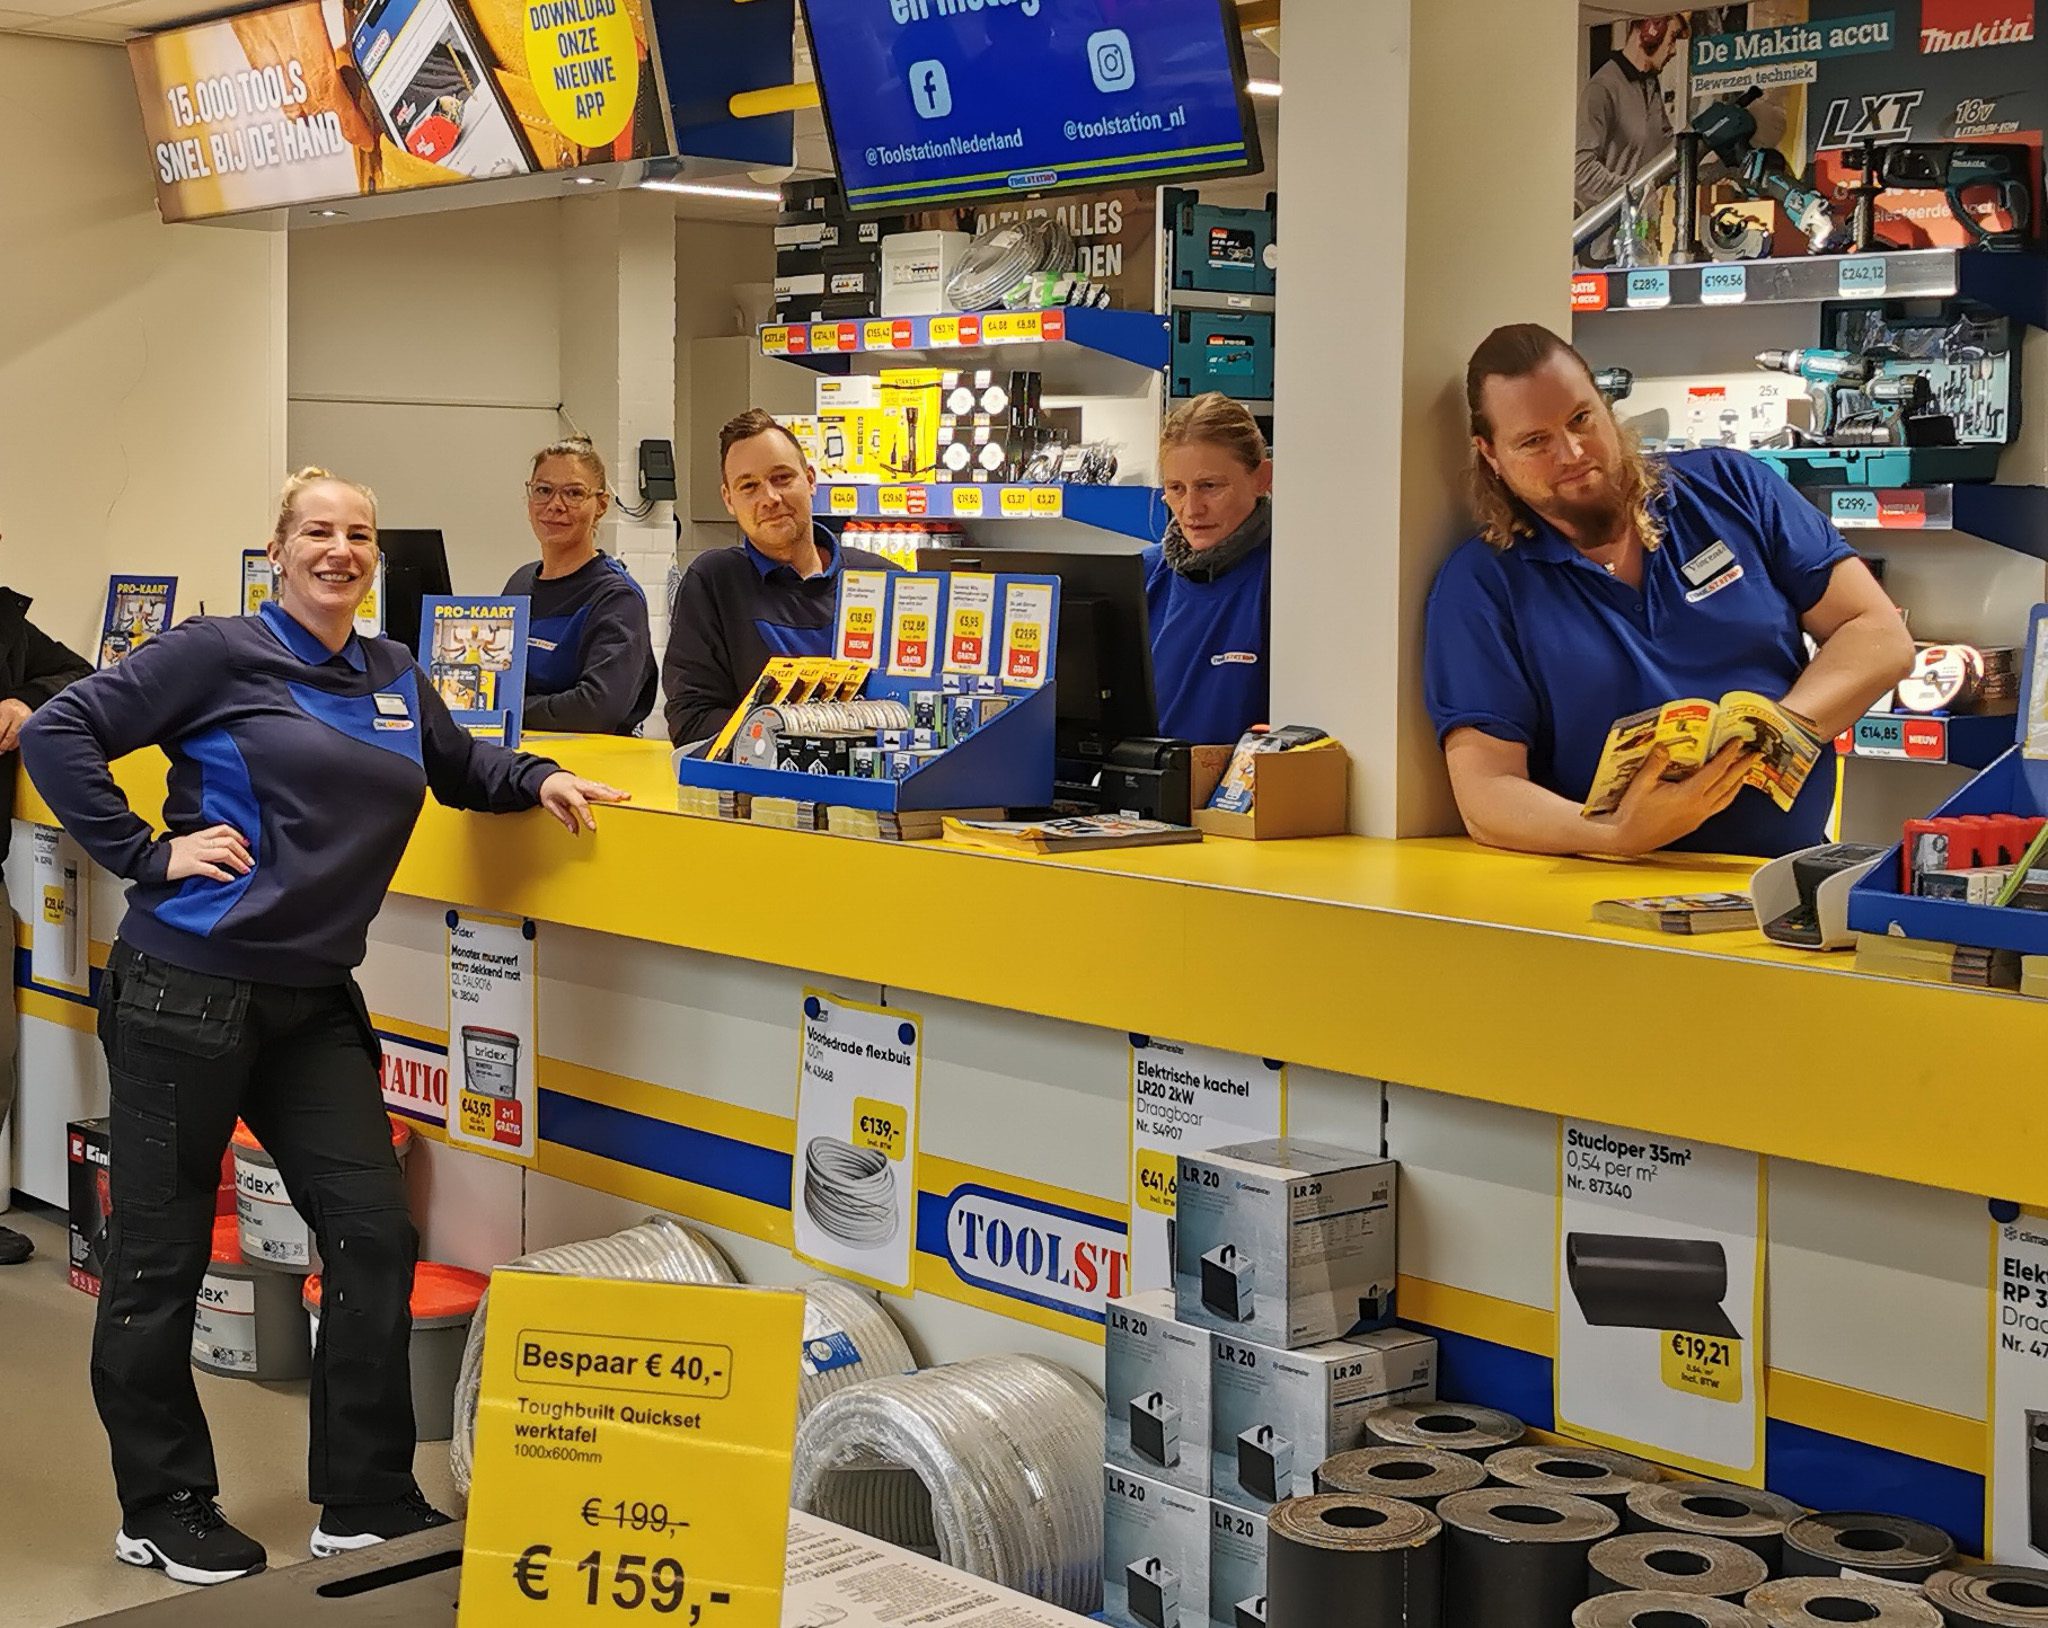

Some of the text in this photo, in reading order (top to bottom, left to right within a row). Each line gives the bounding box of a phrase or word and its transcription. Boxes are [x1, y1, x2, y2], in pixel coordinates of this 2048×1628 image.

[557, 27, 600, 59] ONZE
[1696, 21, 1889, 66] De Makita accu
[554, 57, 617, 91] NIEUWE
[1693, 62, 1814, 92] Bewezen techniek
[168, 59, 308, 128] 15.000 TOOLS
[575, 91, 605, 119] APP
[1063, 105, 1186, 141] @toolstation_nl
[1817, 90, 1926, 150] LXT
[156, 111, 345, 184] SNEL BIJ DE HAND
[865, 129, 1023, 167] @ToolstationNederland
[1056, 199, 1123, 237] ALLES
[1632, 278, 1665, 292] €289,-
[1841, 266, 1884, 282] €242,12
[1837, 497, 1873, 512] €299,-
[117, 583, 169, 594] PRO-KAART
[434, 605, 516, 619] PRO-KAART
[1860, 725, 1899, 743] €14,85
[1908, 735, 1939, 745] NIEUW
[474, 1045, 508, 1061] bridex
[866, 1045, 911, 1066] flexbuis
[1137, 1060, 1250, 1098] Elektrische kachel
[1137, 1079, 1195, 1105] LR20 2kW
[461, 1097, 492, 1118] €43,93
[1137, 1098, 1203, 1127] Draagbaar
[859, 1115, 900, 1141] €139,-
[1136, 1119, 1183, 1141] Nr. 54907
[1567, 1128, 1647, 1160] Stucloper
[1182, 1165, 1220, 1188] LR 20
[1567, 1149, 1601, 1173] 0,54
[1605, 1159, 1632, 1181] per
[1293, 1182, 1323, 1199] LR 20
[1567, 1174, 1633, 1200] Nr. 87340
[957, 1209, 1129, 1299] TOOLST
[2003, 1281, 2048, 1309] RP 3
[1111, 1312, 1147, 1337] LR 20
[1217, 1343, 1256, 1368] LR 20
[1672, 1333, 1729, 1367] €19,21
[2002, 1332, 2025, 1353] Nr.
[522, 1343, 723, 1385] Bespaar € 40,-
[1333, 1363, 1362, 1381] LR 20
[517, 1397, 702, 1429] Toughbuilt Quickset
[515, 1422, 597, 1443] werktafel
[513, 1443, 603, 1464] 1000x600mm
[1108, 1475, 1146, 1502] LR 20
[581, 1497, 691, 1539] € 199,-
[1214, 1510, 1254, 1538] LR 20
[512, 1544, 553, 1602] €
[576, 1549, 731, 1628] 159,-
